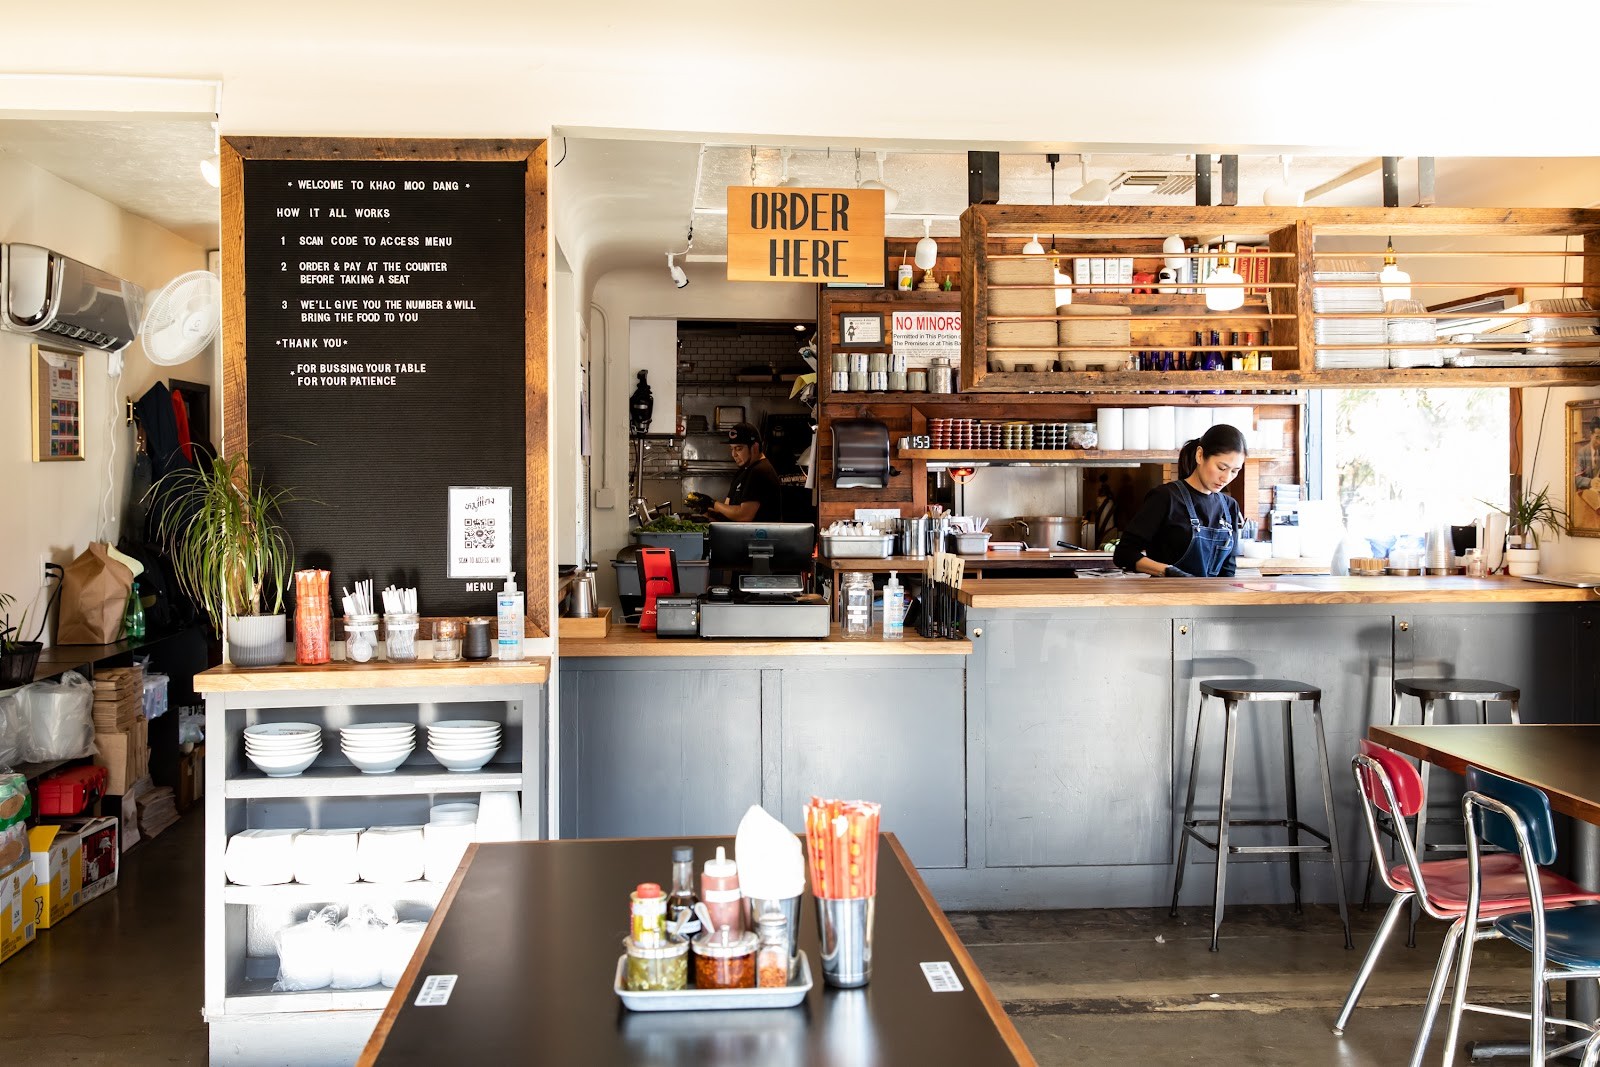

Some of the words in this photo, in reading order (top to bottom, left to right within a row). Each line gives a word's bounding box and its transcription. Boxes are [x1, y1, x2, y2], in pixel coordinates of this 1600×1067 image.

[298, 180, 343, 189] WELCOME
[351, 181, 363, 189] TO
[370, 181, 395, 190] KHAO
[404, 181, 425, 190] MOO
[433, 181, 458, 190] DANG
[277, 208, 299, 217] HOW
[310, 208, 319, 217] IT
[329, 208, 347, 217] ALL
[355, 209, 390, 217] WORKS
[751, 192, 849, 231] ORDER
[281, 236, 285, 245] 1
[299, 236, 323, 245] SCAN
[331, 236, 357, 245] CODE
[363, 237, 376, 245] TO
[380, 237, 419, 246] ACCESS
[425, 237, 452, 246] MENU
[770, 239, 848, 277] HERE
[281, 262, 287, 271] 2
[299, 262, 329, 271] ORDER
[334, 262, 339, 271] &
[344, 262, 361, 271] PAY
[367, 262, 378, 271] AT
[383, 262, 401, 271] THE
[406, 262, 447, 271] COUNTER
[301, 275, 334, 284] BEFORE
[340, 275, 374, 284] TAKING
[379, 275, 384, 284] A
[388, 275, 410, 284] SEAT
[282, 300, 287, 309] 3
[335, 300, 358, 309] GIVE
[363, 300, 380, 309] YOU
[385, 300, 402, 309] THE
[406, 300, 443, 309] NUMBER
[446, 301, 452, 309] &
[454, 300, 476, 309] WILL
[301, 313, 330, 322] BRING
[334, 313, 353, 322] THE
[357, 313, 380, 322] FOOD
[384, 313, 394, 322] TO
[399, 313, 418, 322] YOU
[896, 317, 912, 330] NO
[917, 317, 961, 331] MINORS
[297, 364, 316, 373] FOR
[320, 364, 363, 373] BUSSING
[366, 364, 391, 373] YOUR
[395, 364, 426, 373] TABLE
[298, 377, 318, 386] FOR
[320, 377, 347, 386] YOUR
[350, 376, 396, 385] PATIENCE
[466, 582, 493, 592] MENU
